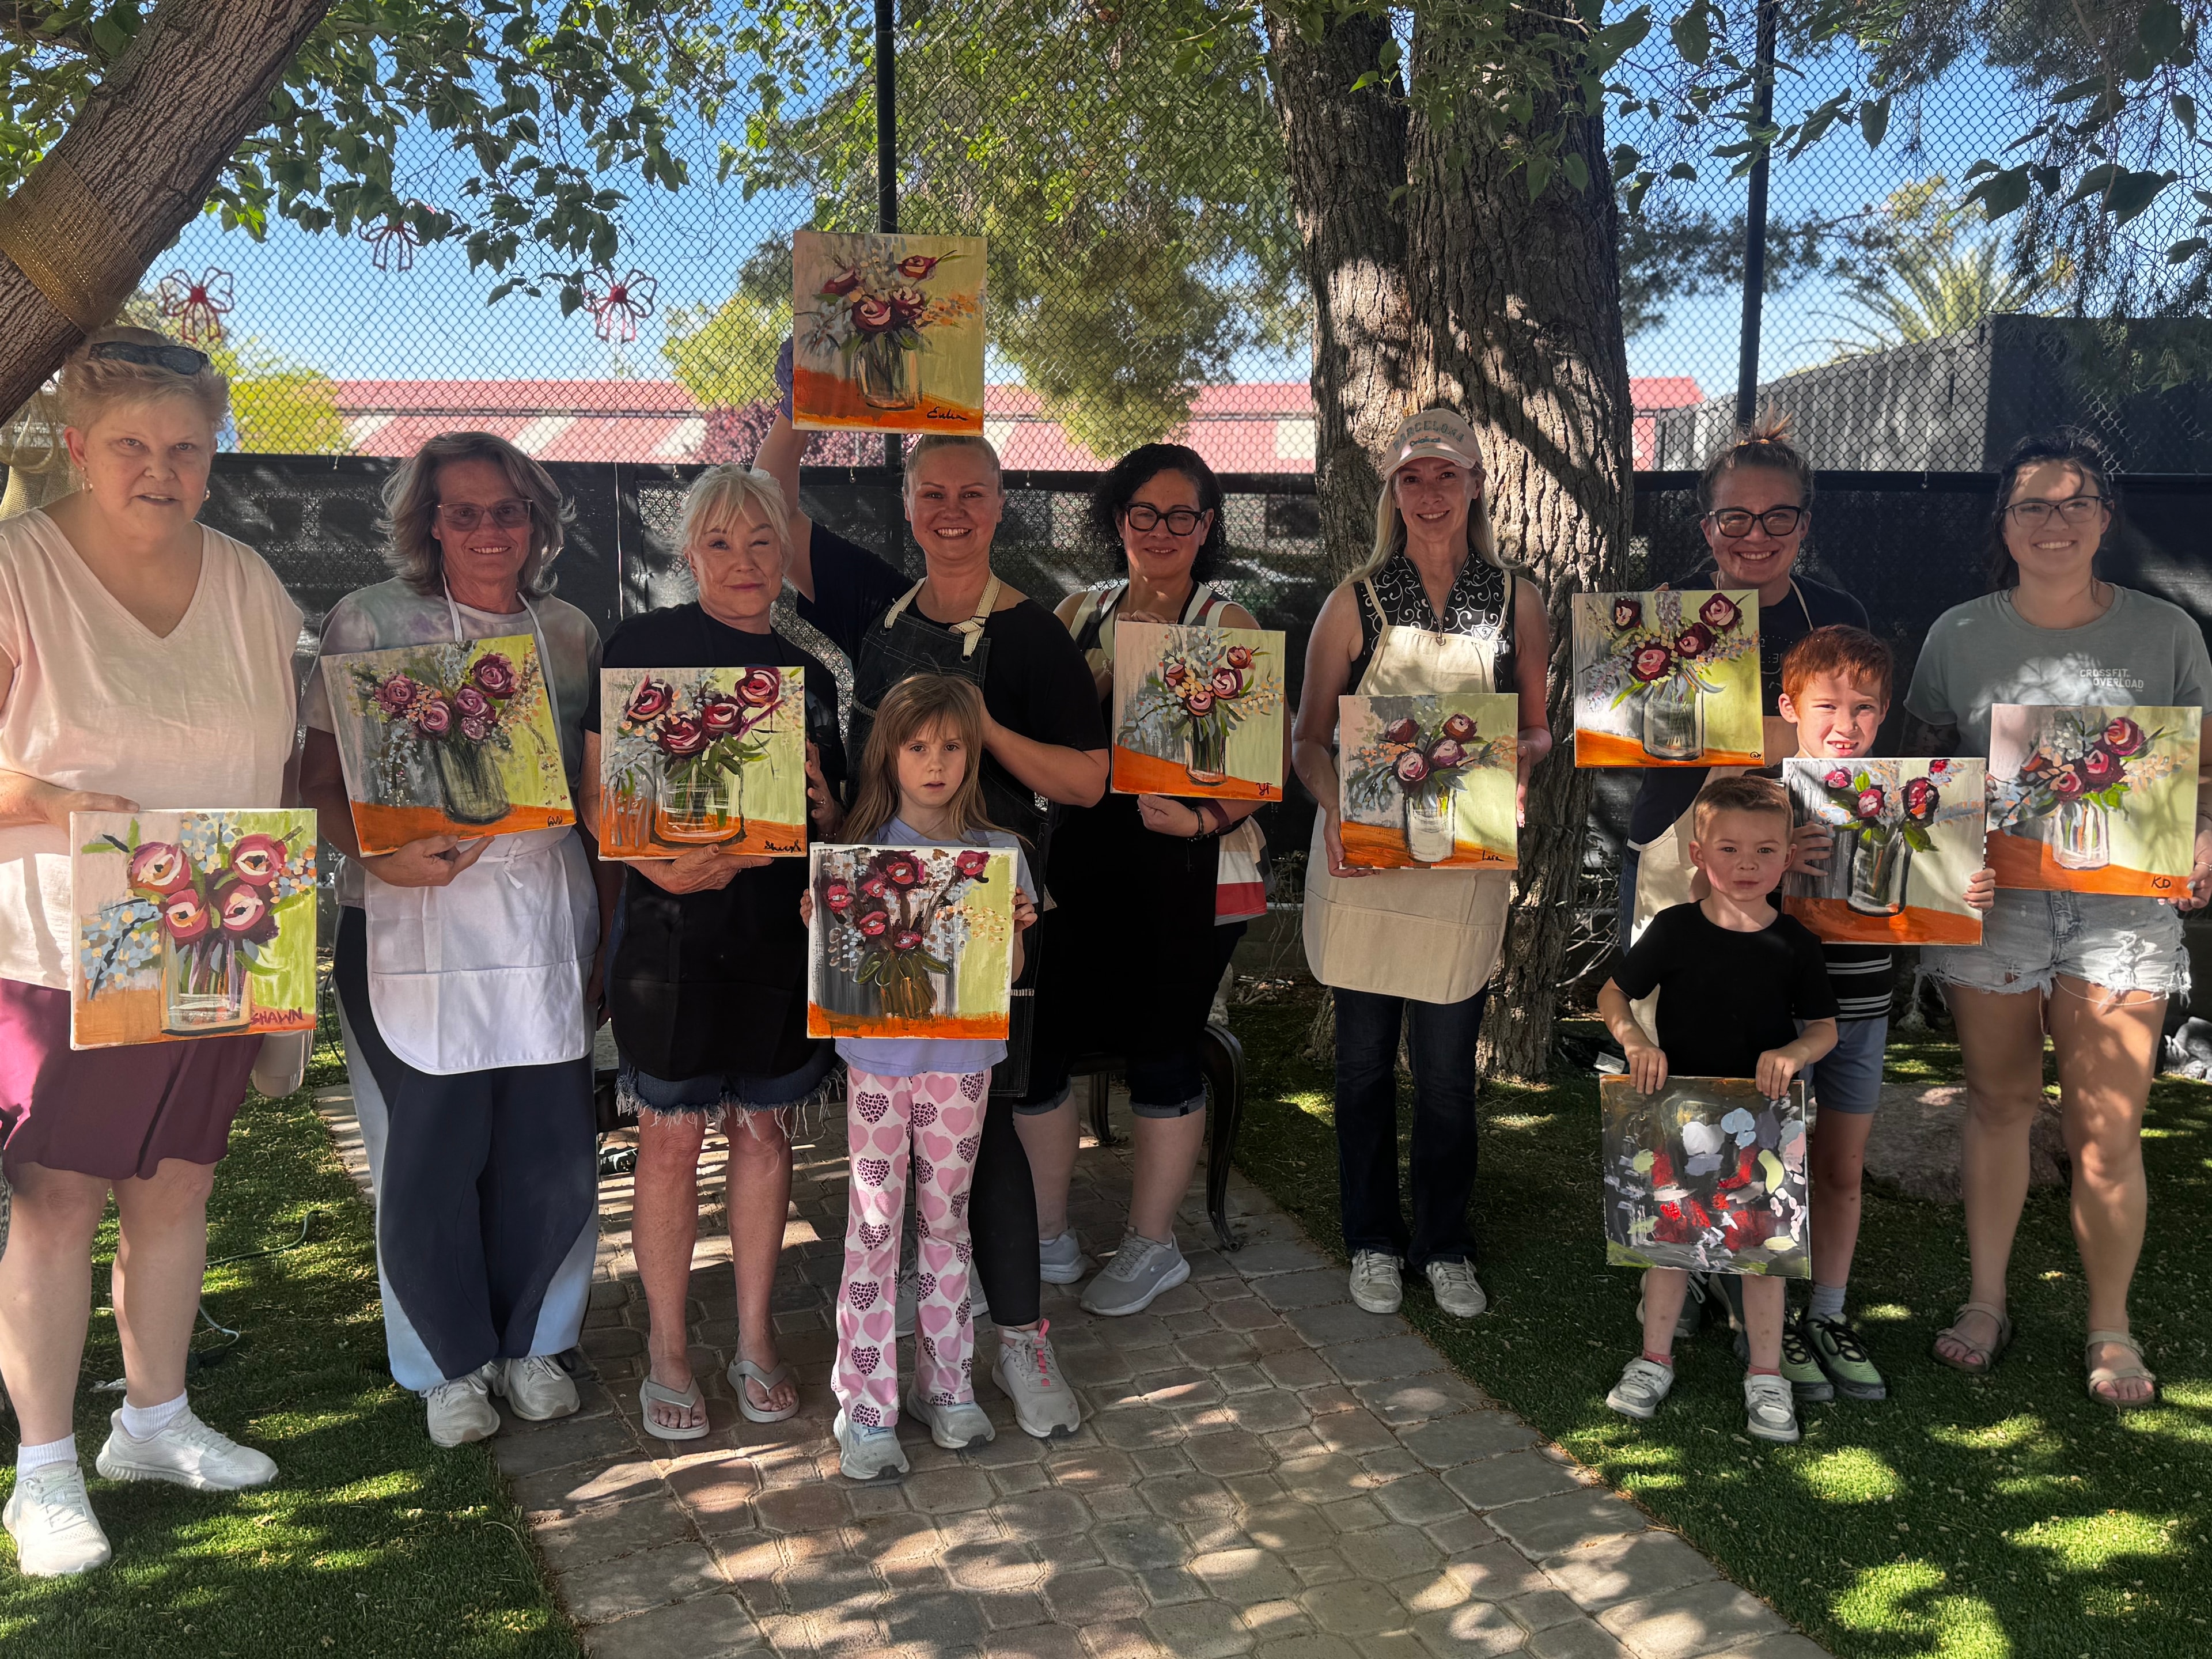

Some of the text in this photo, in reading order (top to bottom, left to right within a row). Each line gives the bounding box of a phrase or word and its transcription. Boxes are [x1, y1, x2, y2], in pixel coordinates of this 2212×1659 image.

[1393, 421, 1465, 452] BARCELONA
[2080, 669, 2128, 677] CROSSFIT
[2093, 677, 2144, 689] OVERLOAD
[2151, 875, 2171, 889] KD
[250, 1007, 304, 1025] SHAWN
